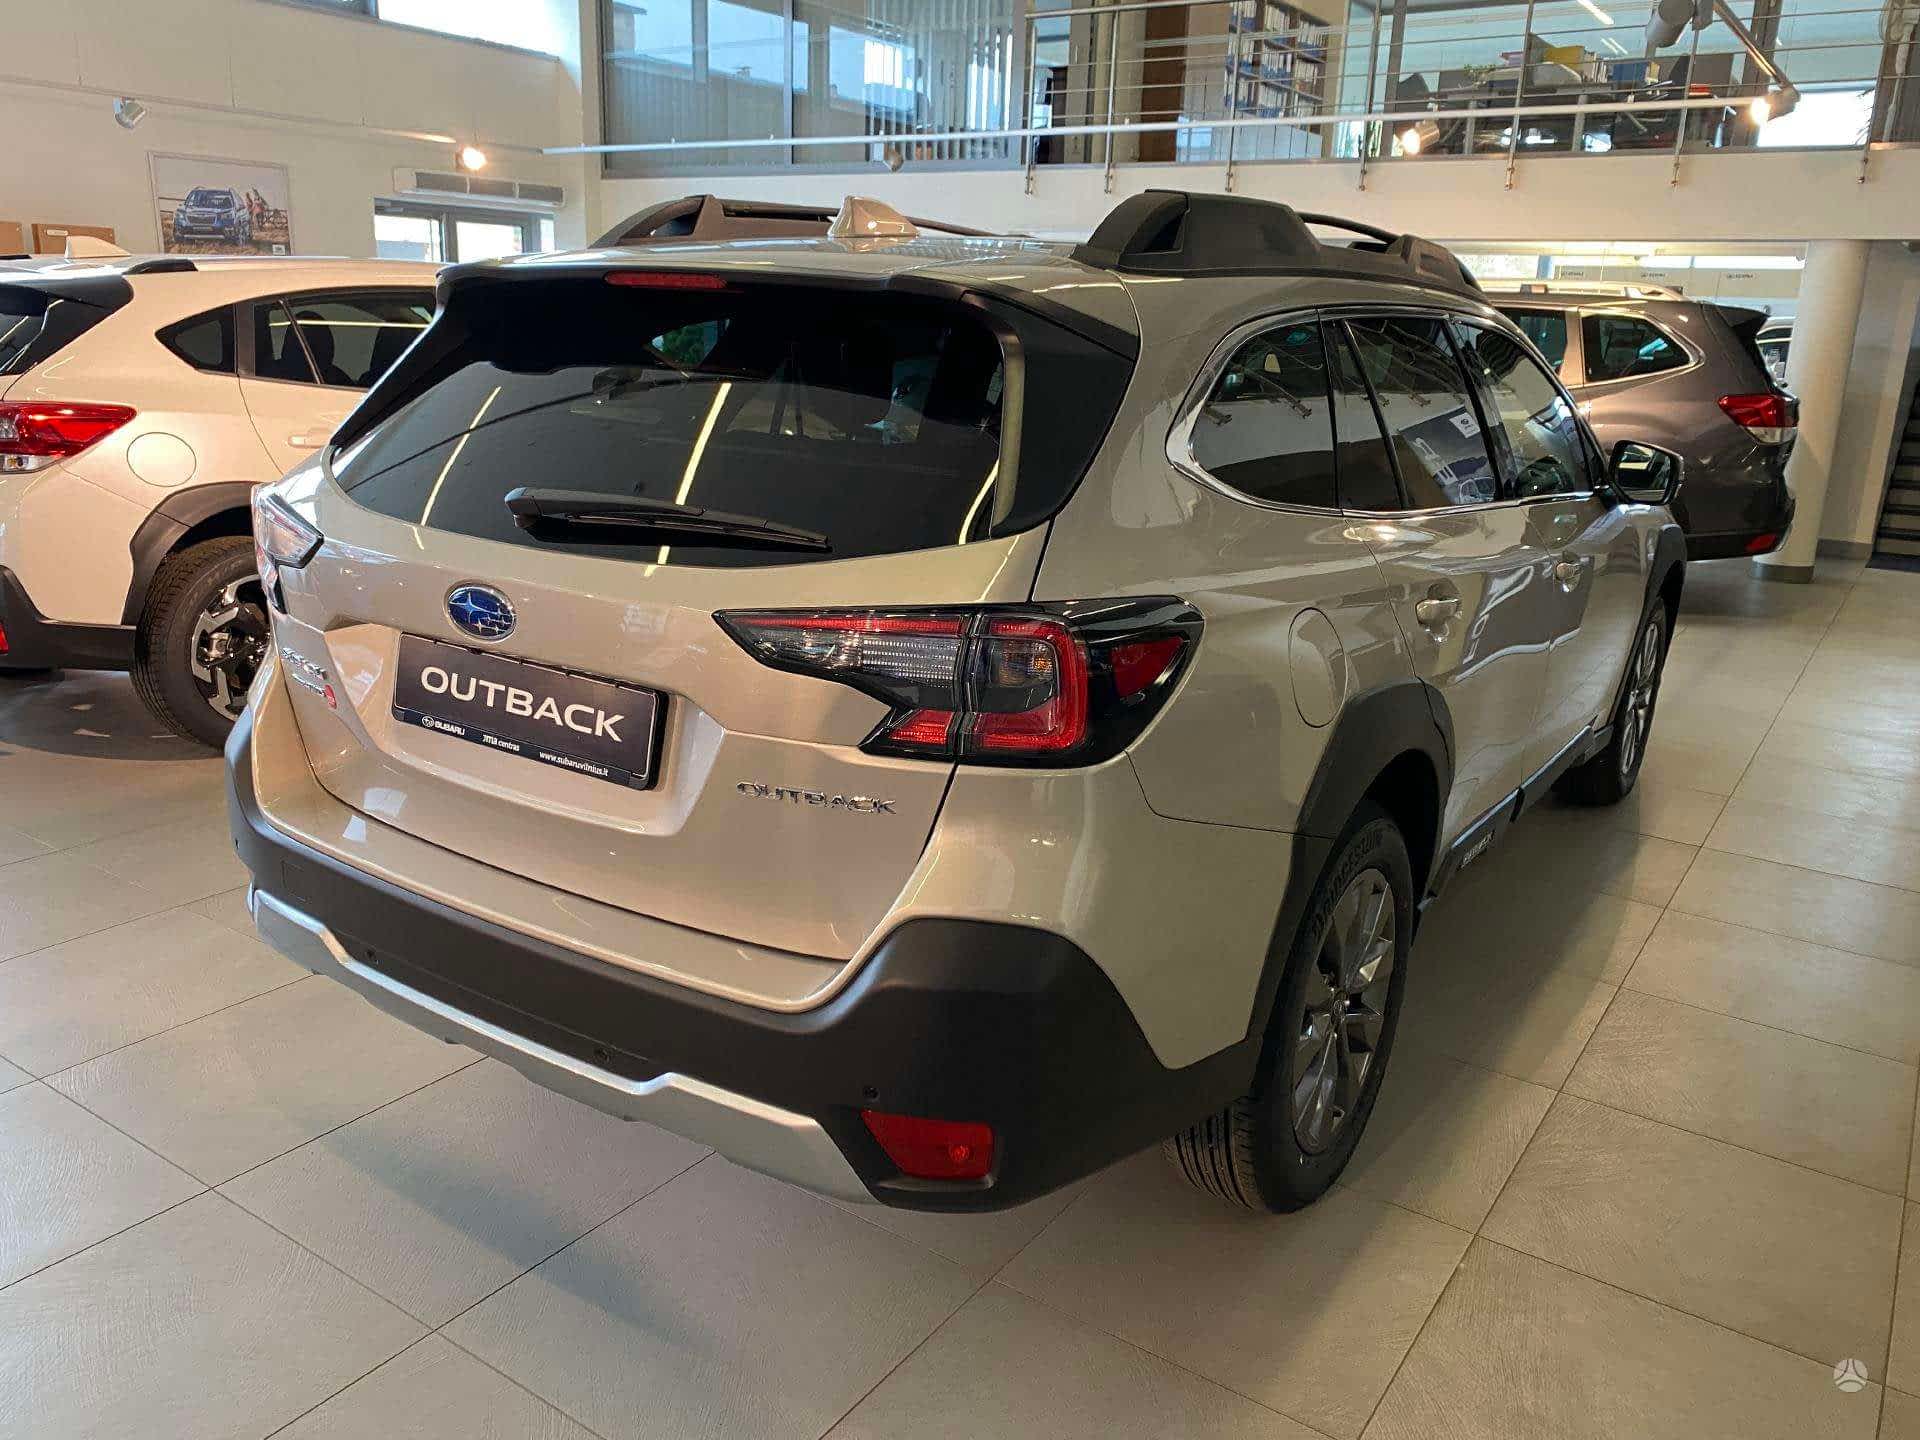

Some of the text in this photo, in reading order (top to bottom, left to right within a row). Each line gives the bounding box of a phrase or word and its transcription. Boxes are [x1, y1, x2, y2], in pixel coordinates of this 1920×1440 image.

[420, 665, 625, 743] OUTBACK
[434, 720, 465, 736] SUBARU
[498, 740, 520, 752] centras
[735, 781, 898, 815] OUTBACK
